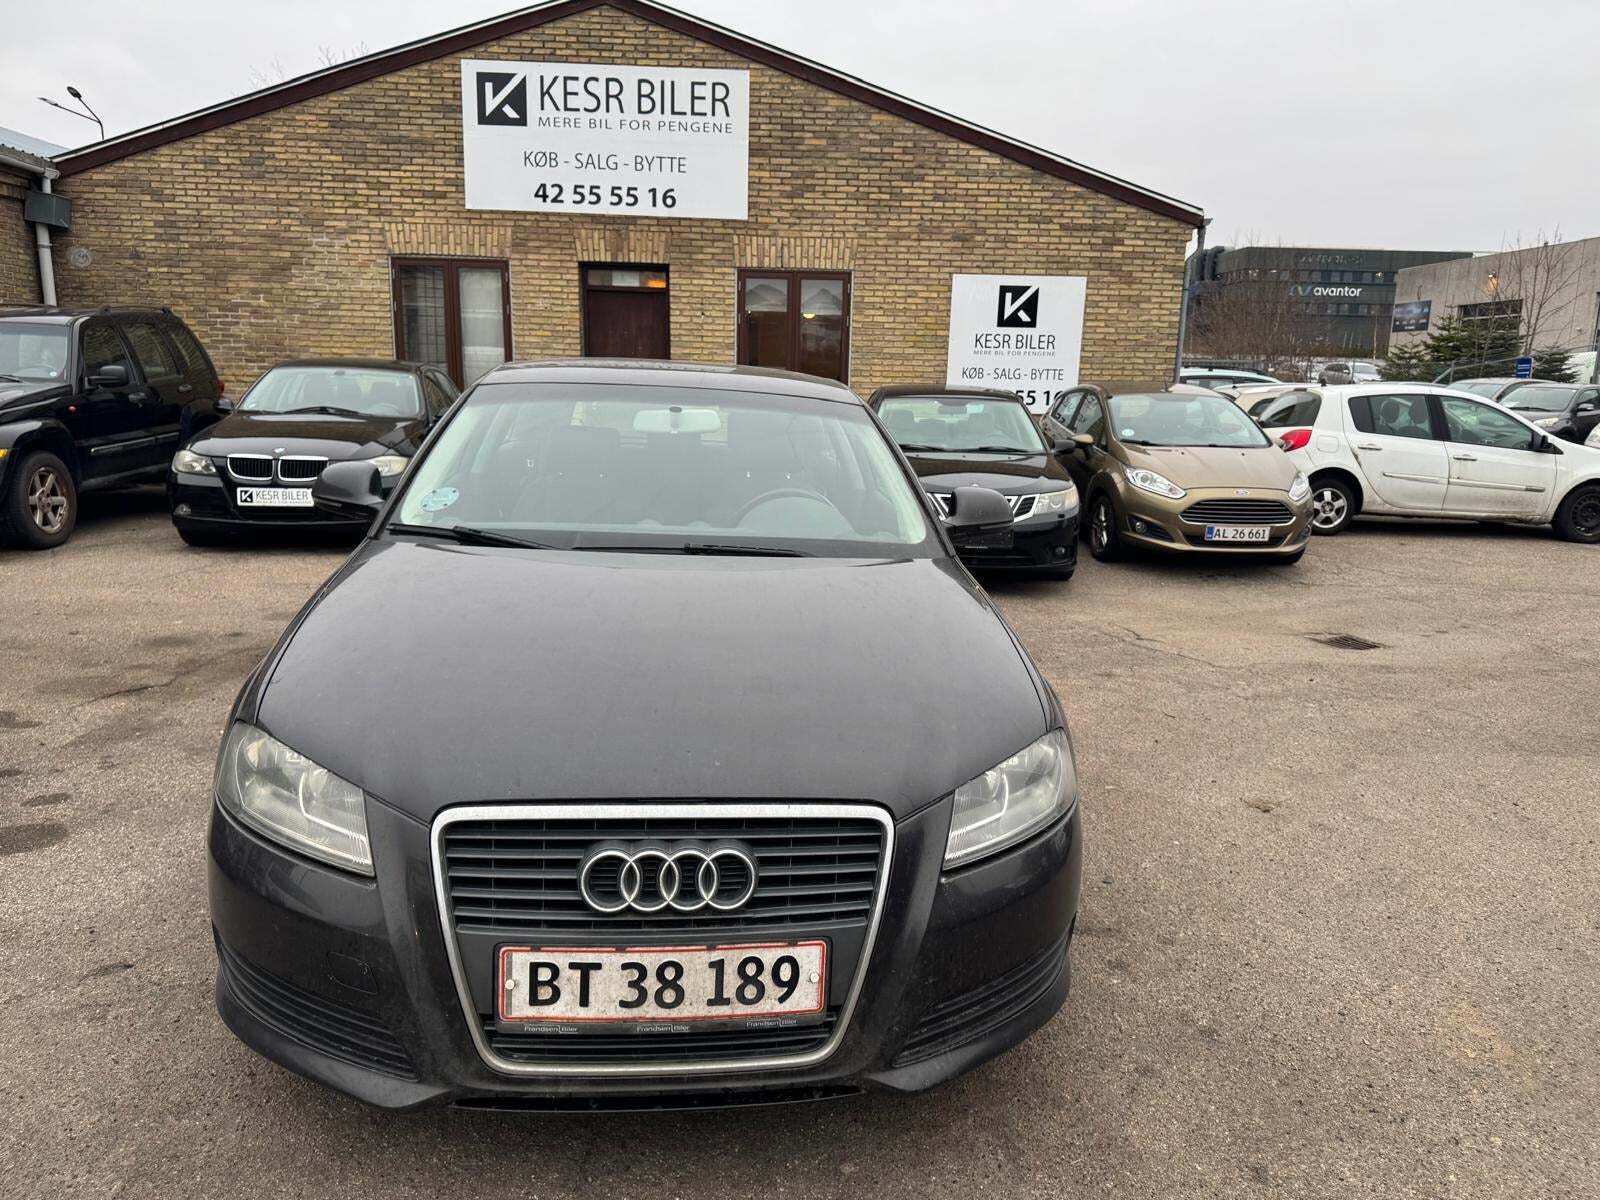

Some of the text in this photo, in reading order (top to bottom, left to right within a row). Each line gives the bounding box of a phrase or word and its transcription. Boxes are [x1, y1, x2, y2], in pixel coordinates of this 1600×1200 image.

[539, 75, 730, 118] KESR BILER
[538, 116, 733, 134] MERE BIL FOR PENGENE
[523, 150, 558, 169] KØB
[574, 152, 618, 171] SALG
[634, 155, 687, 174] BYTTE
[534, 183, 677, 209] 42 55 55 16
[1313, 286, 1362, 297] avantor
[974, 333, 1056, 350] KESR BILER
[962, 367, 984, 379] KØB
[993, 367, 1021, 380] SALG
[1031, 368, 1064, 381] BYTTE
[281, 491, 309, 501] BILER
[1214, 528, 1267, 539] AL 26 661
[528, 955, 801, 1009] BT 38 189
